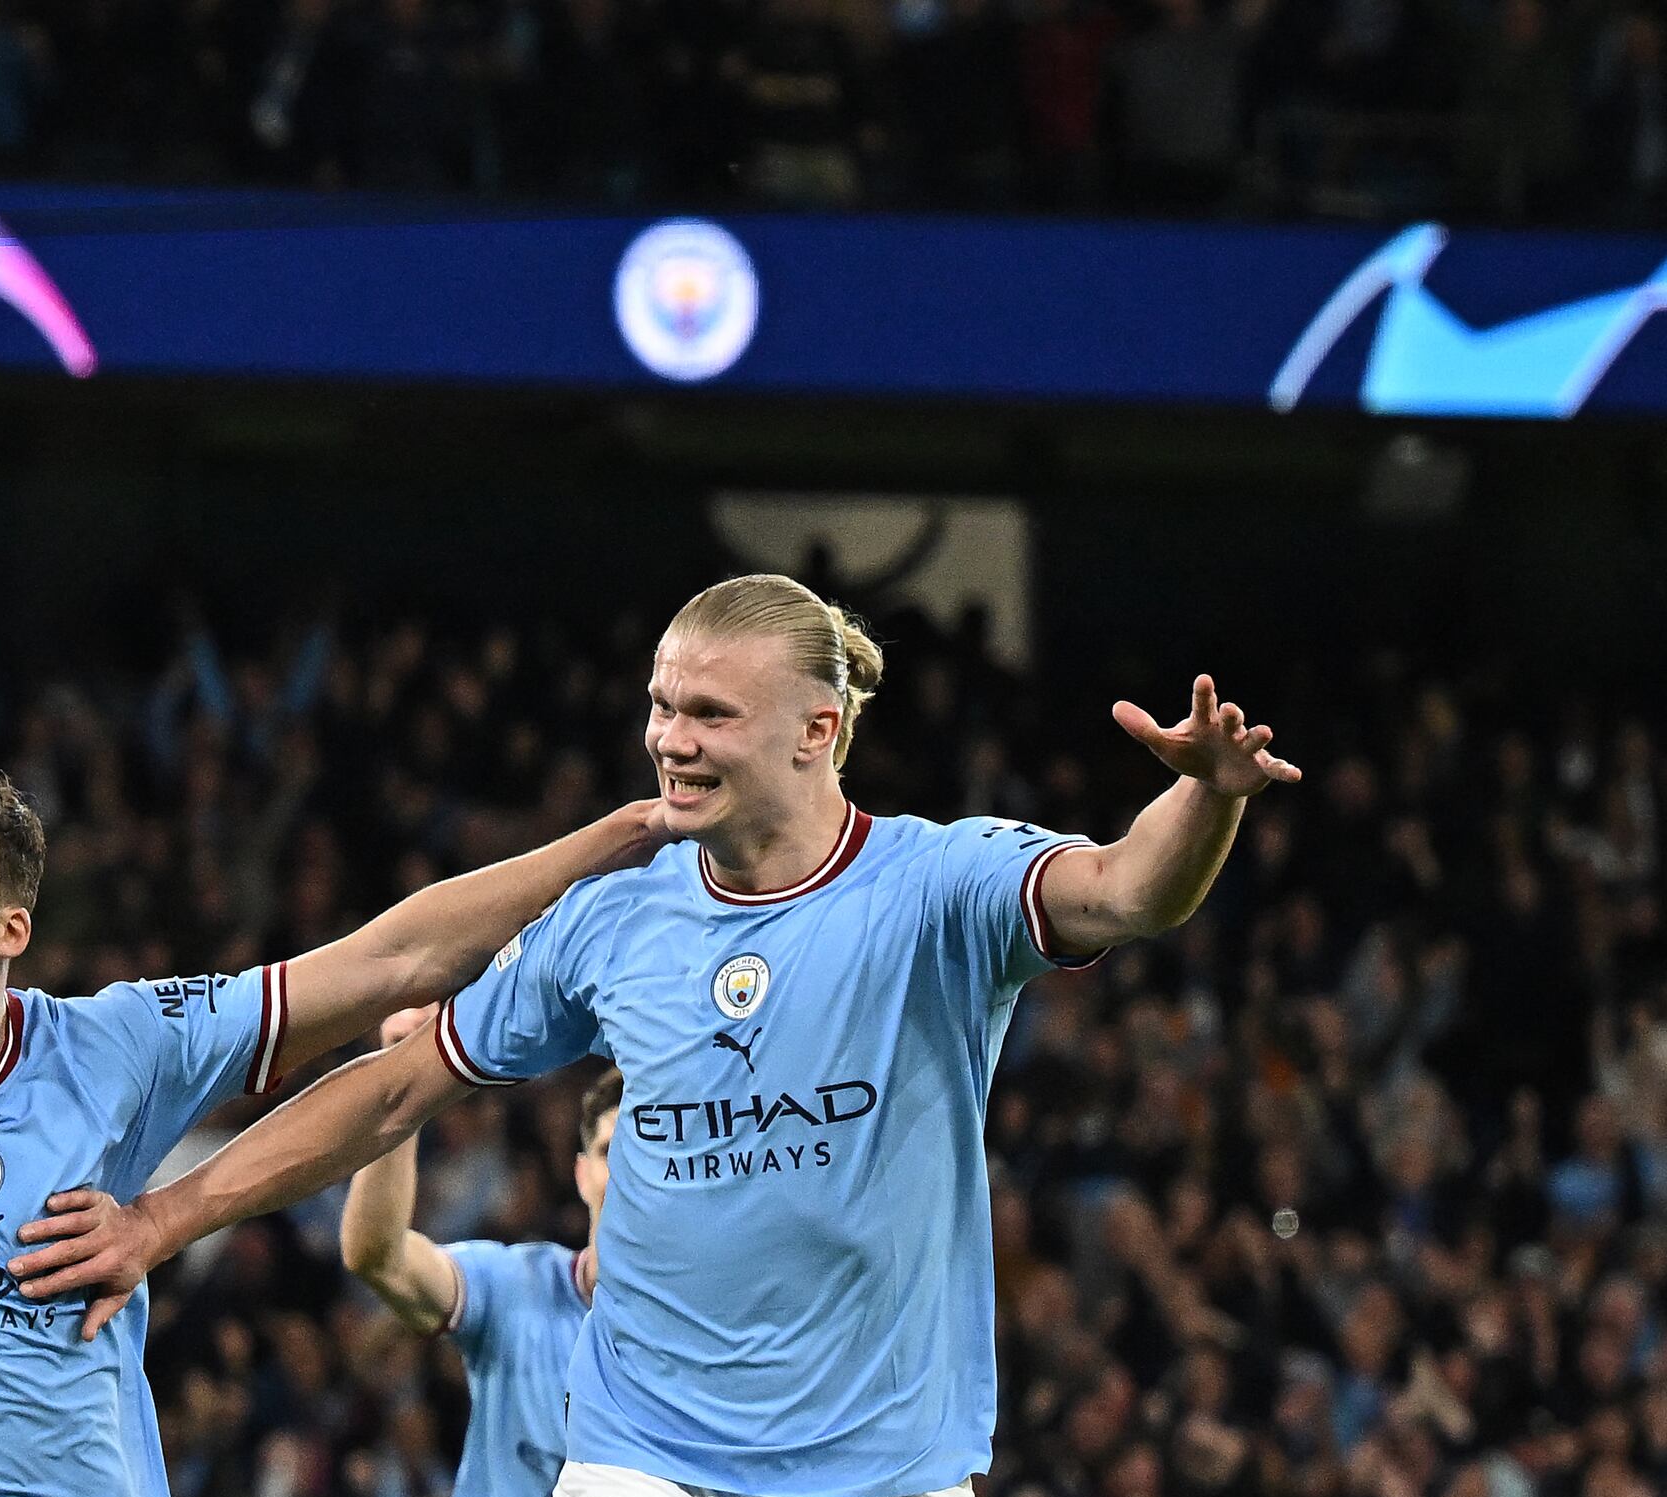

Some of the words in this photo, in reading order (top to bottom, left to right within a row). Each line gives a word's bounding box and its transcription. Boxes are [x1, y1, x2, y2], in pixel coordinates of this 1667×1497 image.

[719, 957, 766, 981] MANCHESTER
[154, 981, 185, 1019] NE
[182, 979, 207, 1001] TI
[733, 1008, 750, 1017] CITY
[633, 1080, 878, 1142] ETIHAD
[664, 1141, 831, 1181] AIRWAYS
